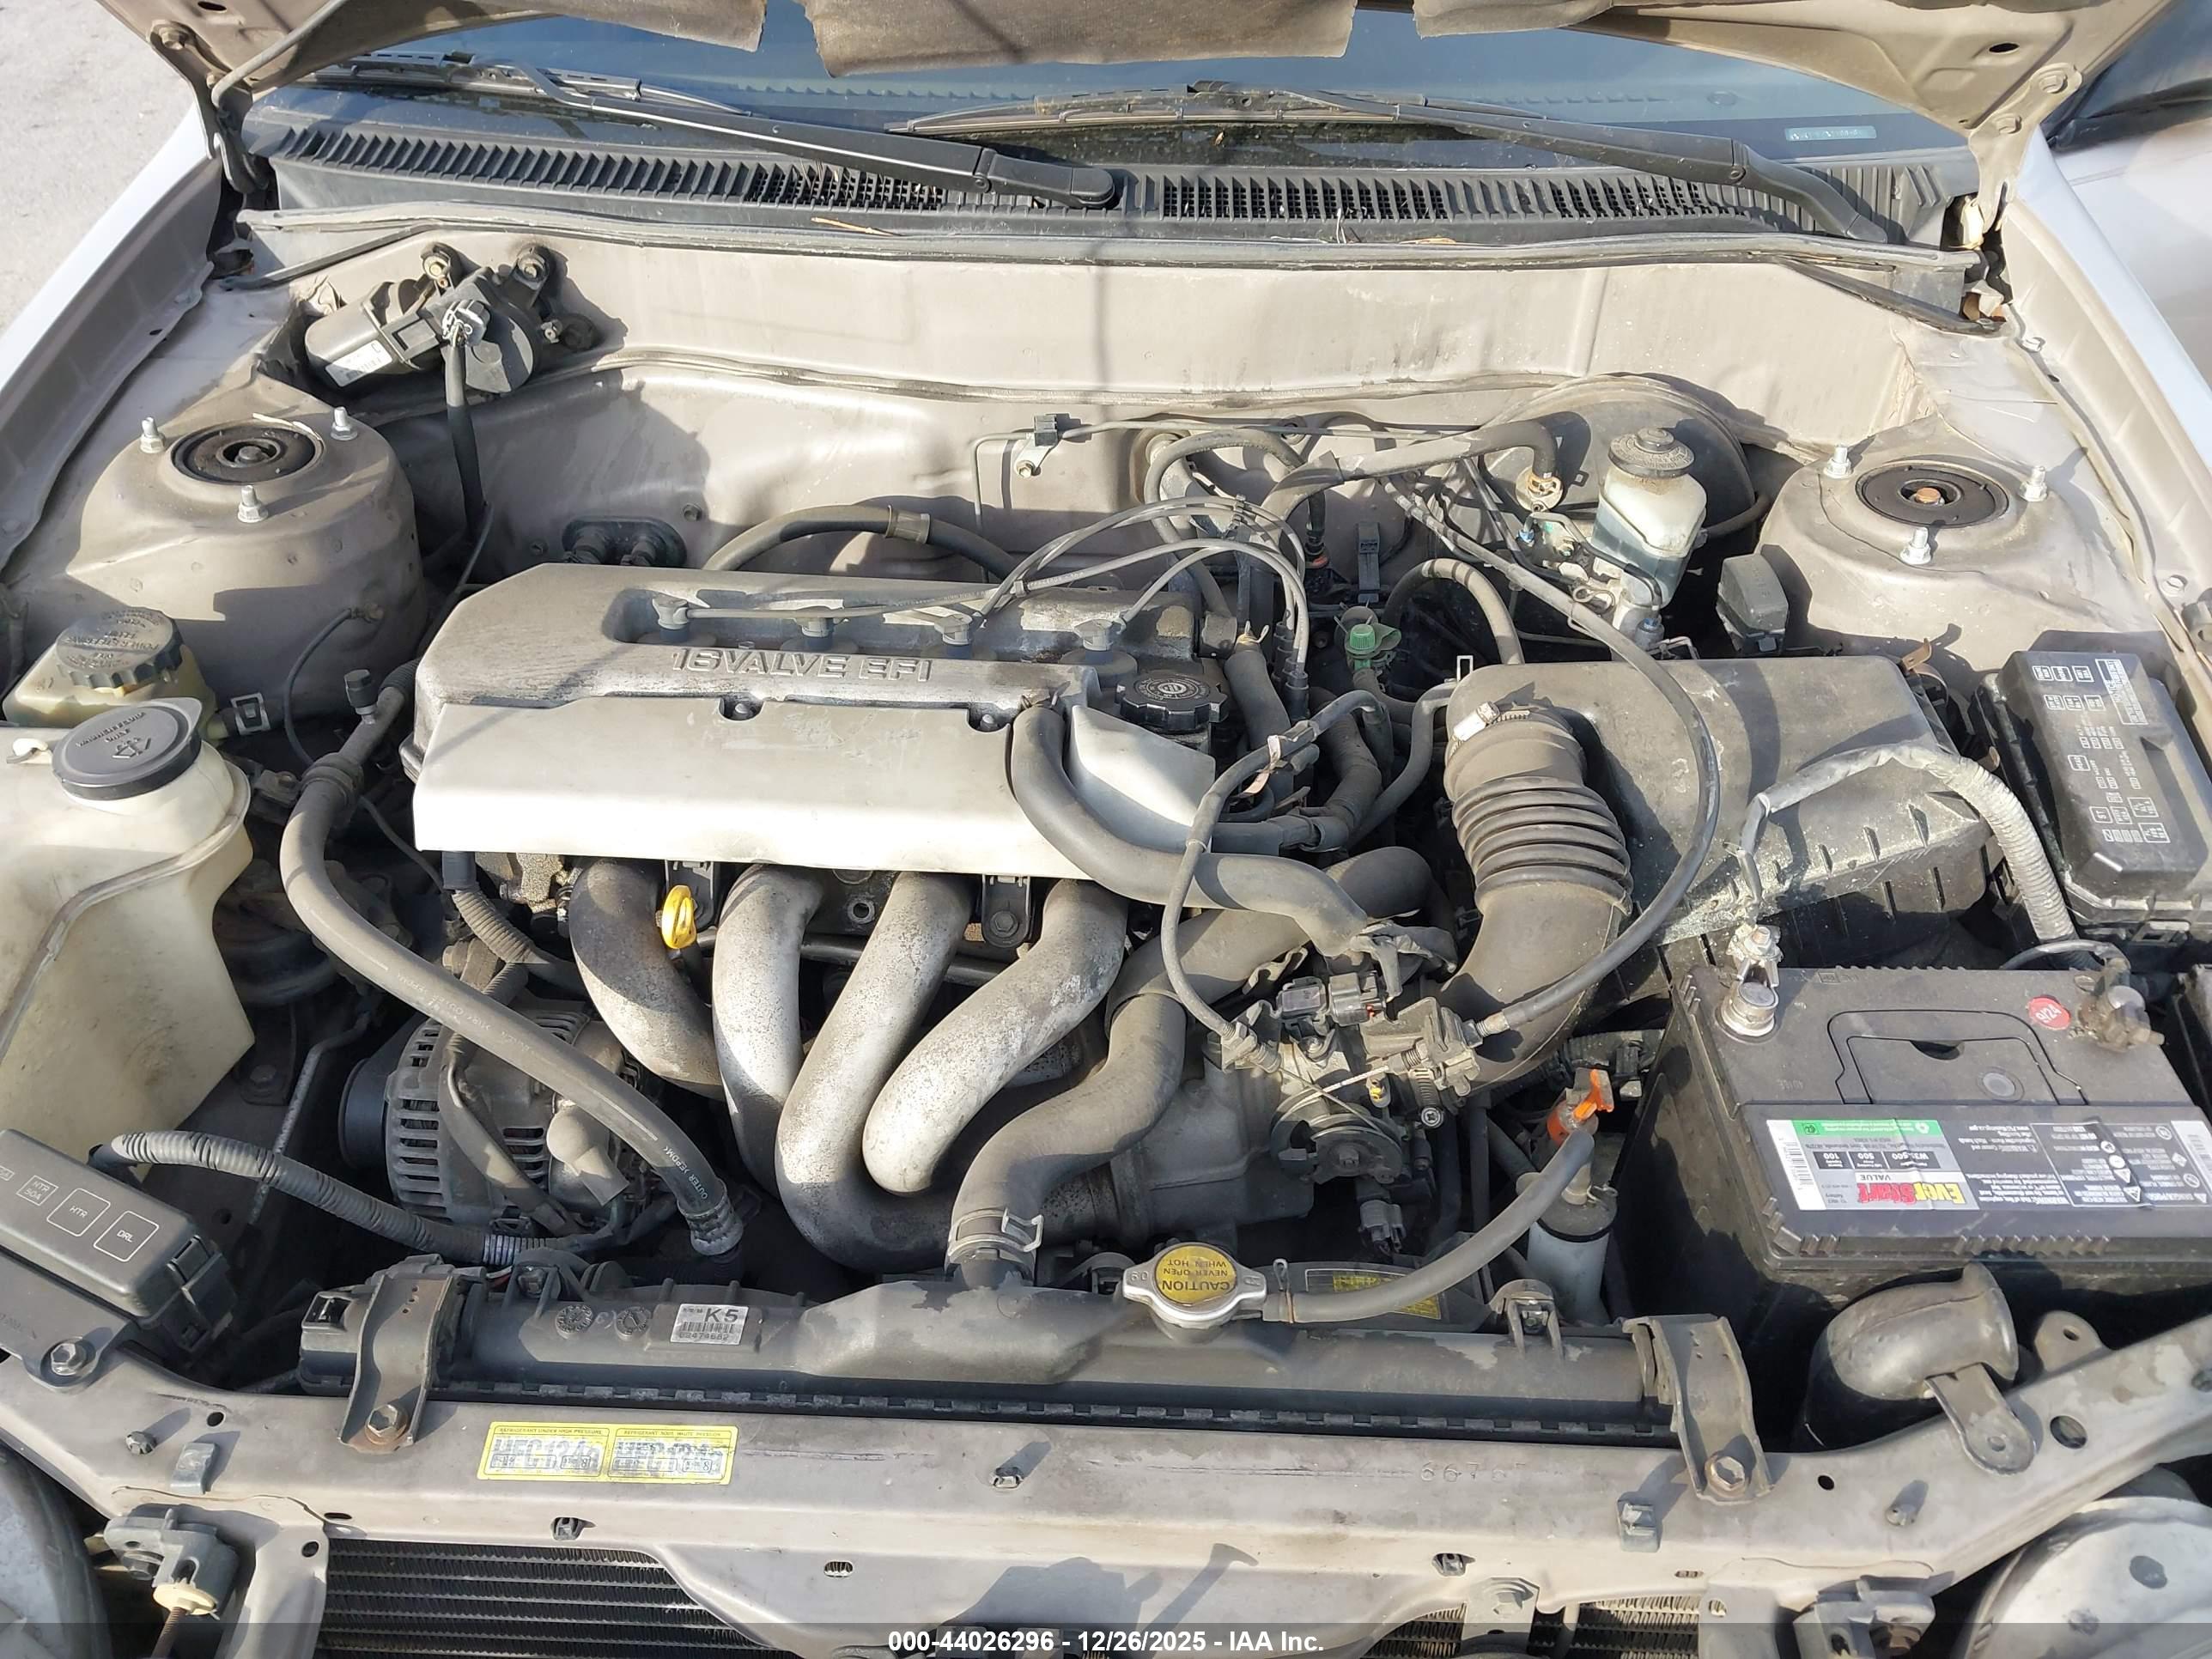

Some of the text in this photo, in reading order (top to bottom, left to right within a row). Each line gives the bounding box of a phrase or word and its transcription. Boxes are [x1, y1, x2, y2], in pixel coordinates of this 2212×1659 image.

[859, 657, 933, 683] EFI
[2095, 810, 2107, 820] ST
[2035, 1003, 2062, 1024] 9/24
[32, 1180, 50, 1193] HTR
[688, 1174, 708, 1200] OUTER
[1856, 1181, 1966, 1206] EverStart
[69, 1205, 88, 1218] HTR
[116, 1230, 134, 1243] DRL
[1194, 1259, 1227, 1268] WHEN
[1163, 1267, 1228, 1278] NEVER OPEN
[1162, 1279, 1231, 1291] CAUTION
[704, 1307, 739, 1323] K5
